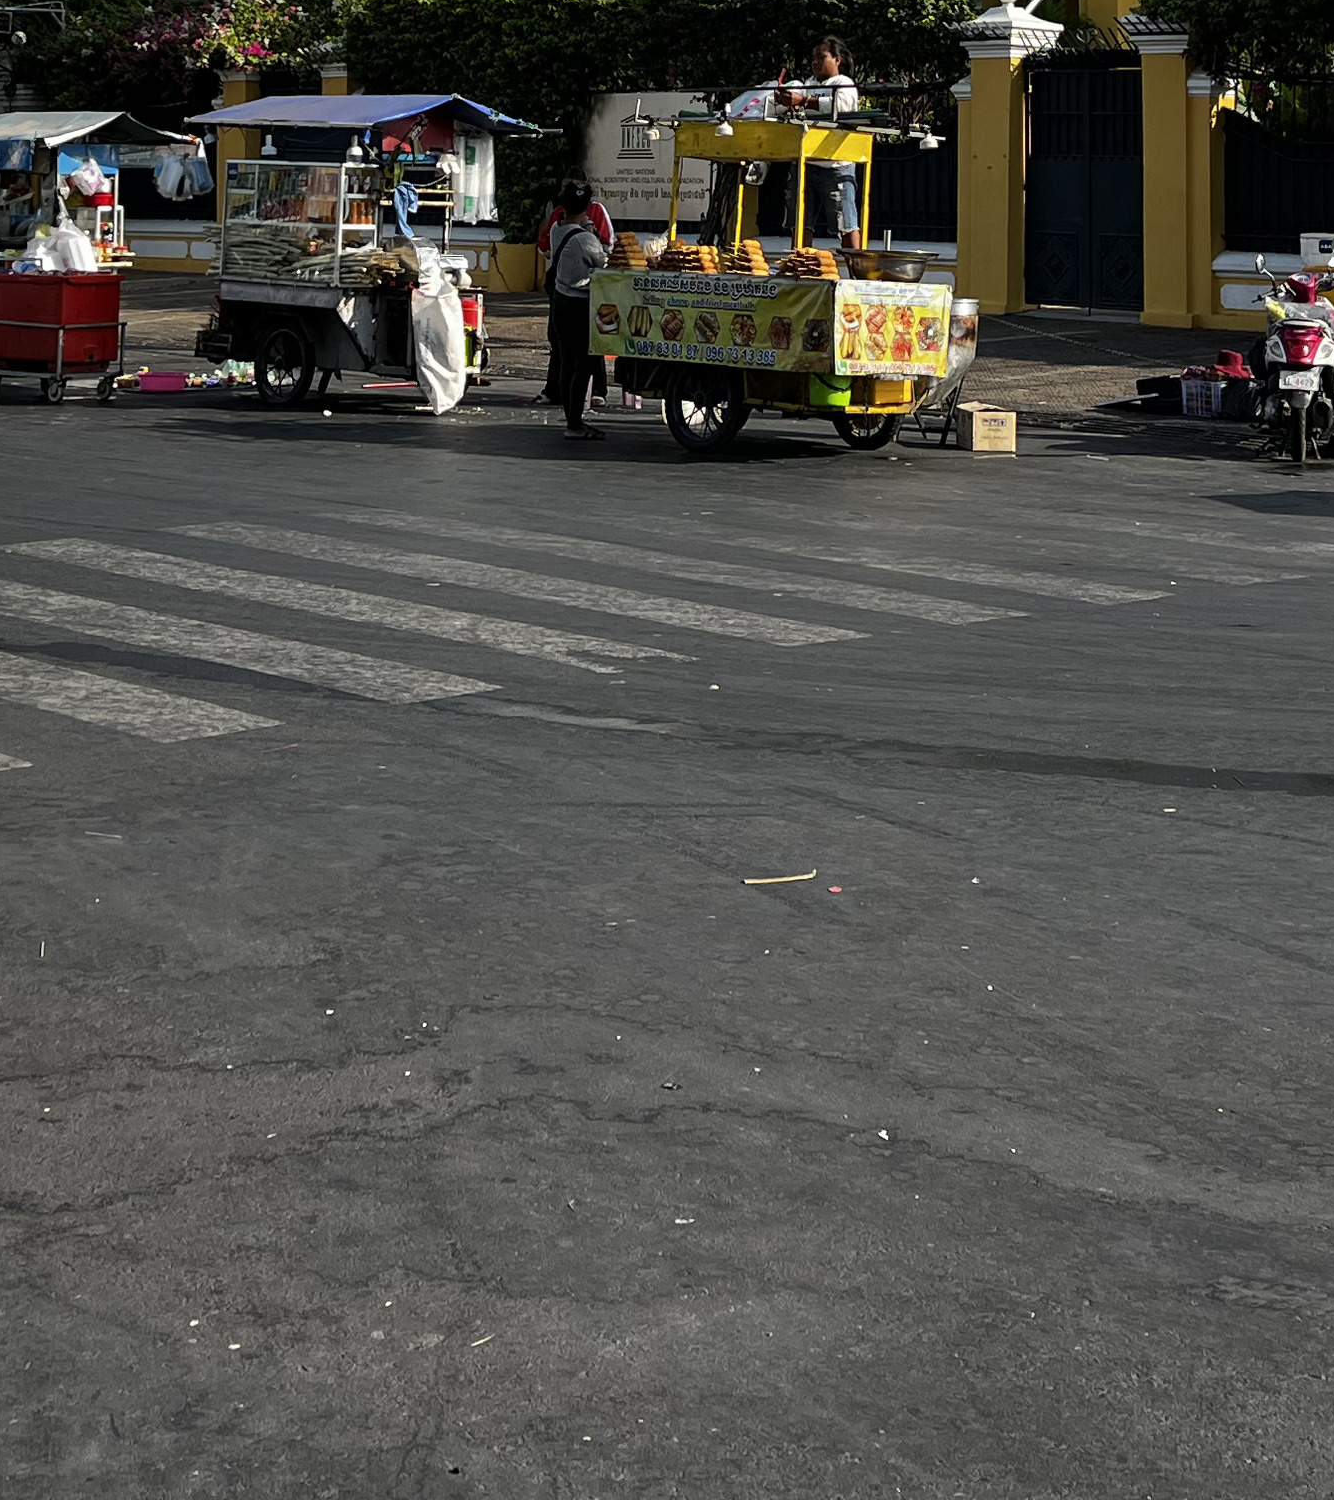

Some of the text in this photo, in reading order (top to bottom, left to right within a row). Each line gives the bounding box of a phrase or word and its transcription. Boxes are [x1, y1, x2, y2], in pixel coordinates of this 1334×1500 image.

[643, 295, 665, 307] Selling
[636, 340, 654, 355] 087
[672, 343, 684, 357] 01
[686, 344, 699, 359] 87
[706, 346, 724, 361] 096
[727, 347, 739, 362] 73
